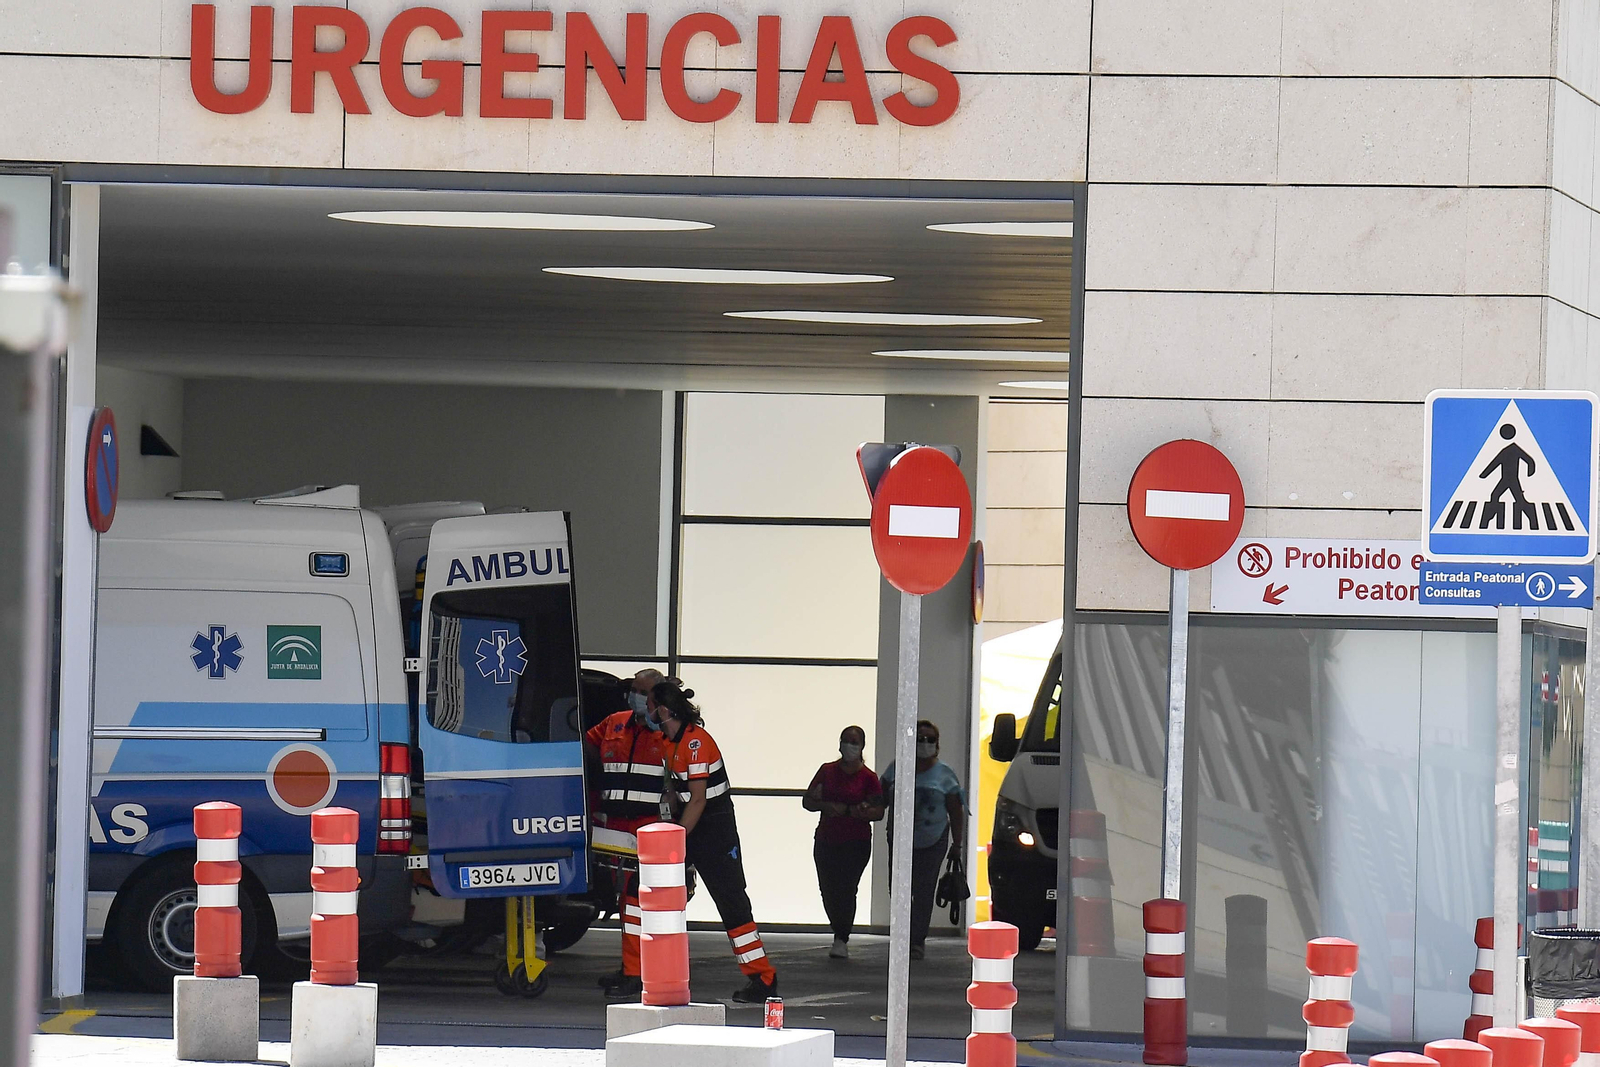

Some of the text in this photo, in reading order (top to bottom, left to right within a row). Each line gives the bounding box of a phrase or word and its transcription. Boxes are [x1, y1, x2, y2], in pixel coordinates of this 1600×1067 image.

[190, 4, 961, 127] URGENCIAS
[1285, 546, 1431, 570] Prohibido e
[1425, 570, 1525, 583] Entrada Peatonal
[1425, 586, 1481, 598] Consultas
[512, 815, 586, 834] URGE
[471, 865, 556, 885] 3964 JVC
